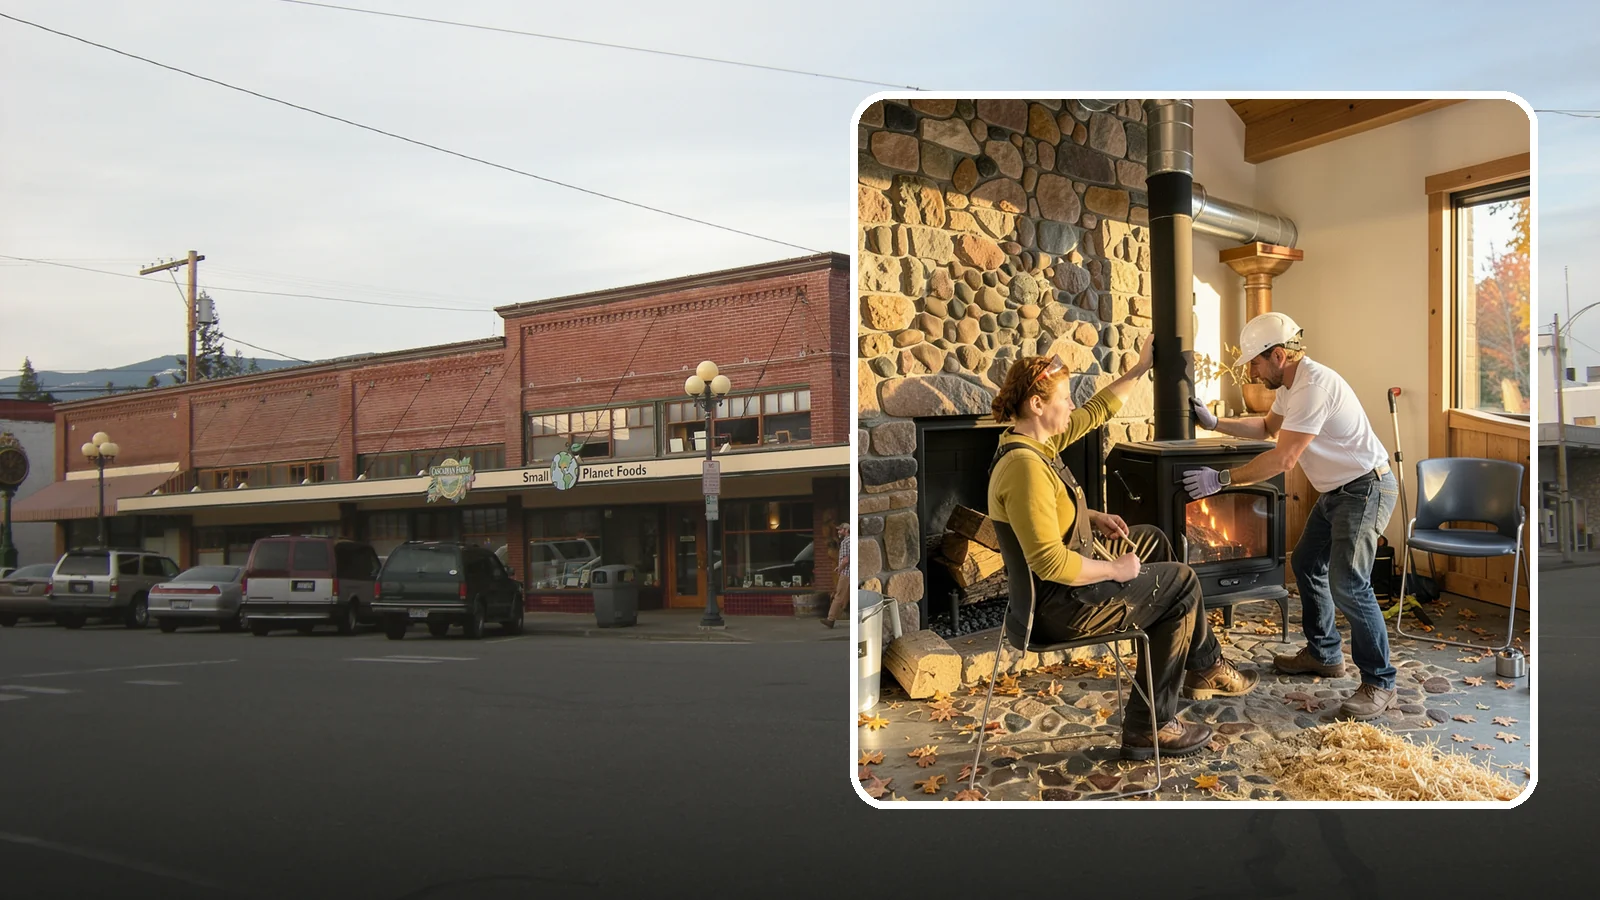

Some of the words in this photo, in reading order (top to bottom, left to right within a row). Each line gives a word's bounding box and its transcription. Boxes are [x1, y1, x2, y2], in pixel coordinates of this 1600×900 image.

[523, 471, 549, 483] Small
[583, 467, 614, 479] Planet
[617, 464, 647, 477] Foods
